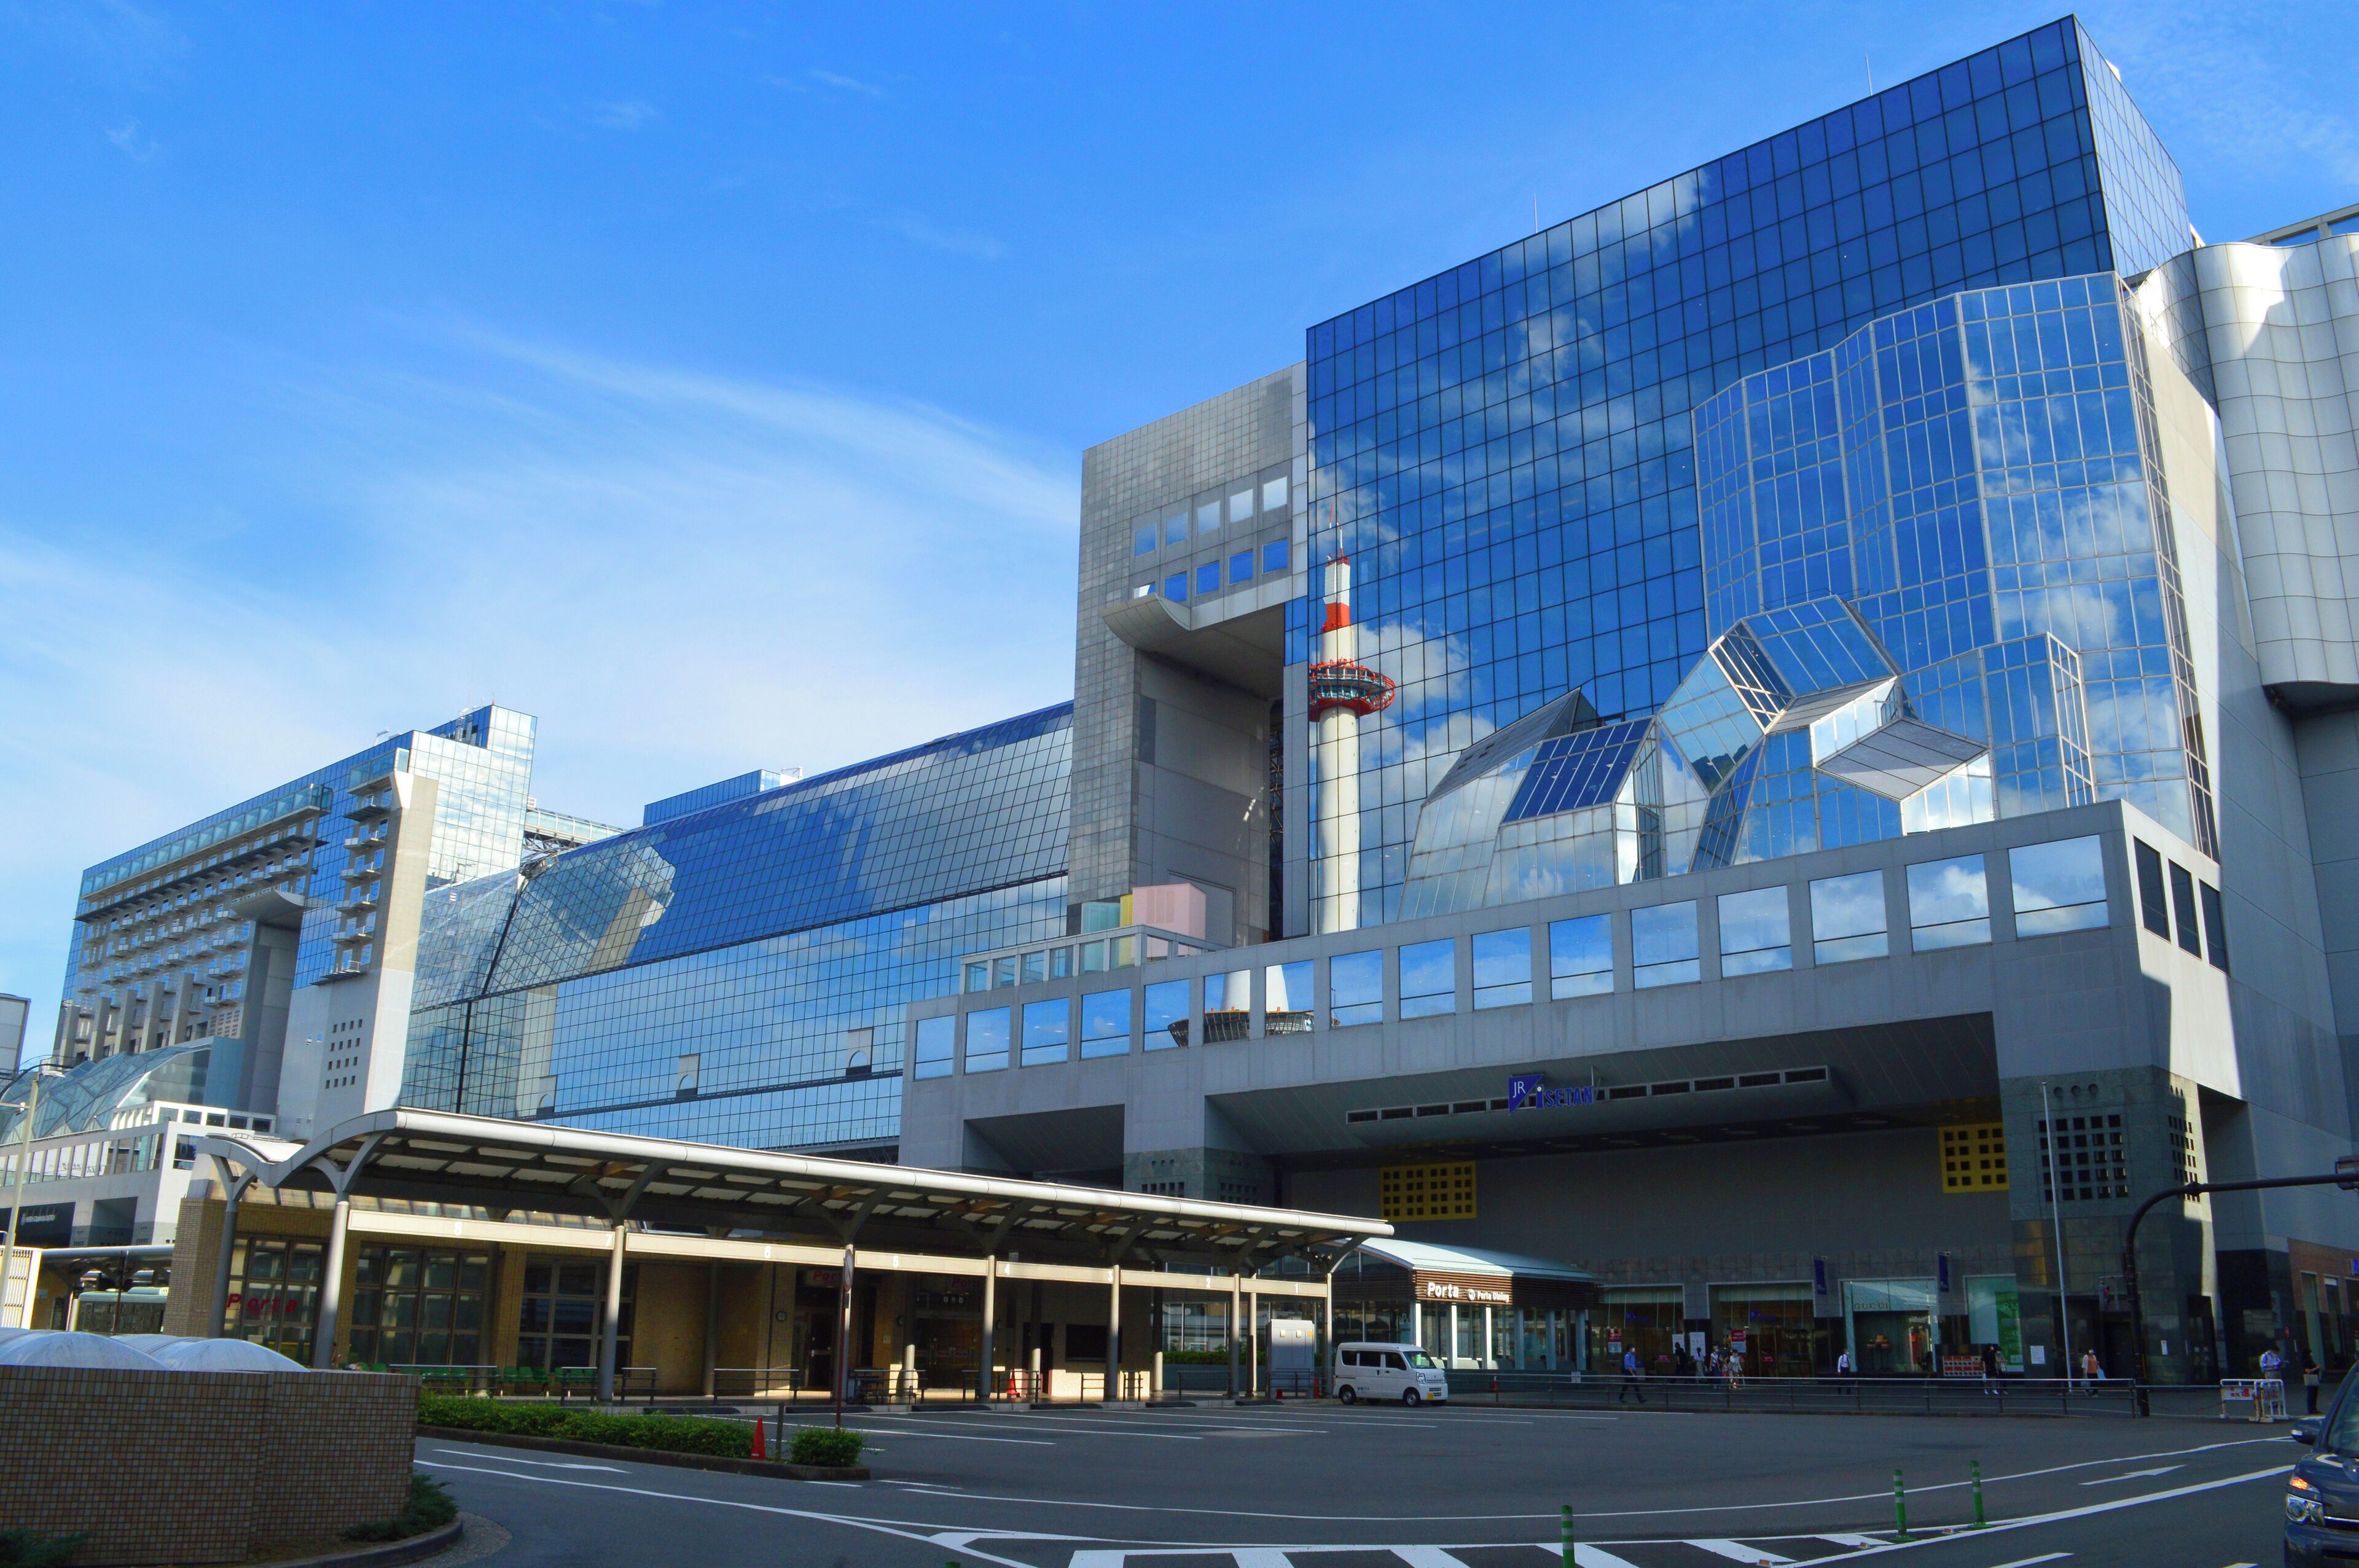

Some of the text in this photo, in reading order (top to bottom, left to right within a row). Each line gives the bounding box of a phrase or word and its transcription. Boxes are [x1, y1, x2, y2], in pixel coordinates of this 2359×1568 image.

[1512, 1081, 1526, 1098] JR
[453, 1222, 462, 1236] 8
[604, 1234, 614, 1246] 7
[764, 1246, 772, 1258] 6
[892, 1255, 899, 1268] 5
[1004, 1263, 1011, 1276] 4
[1107, 1270, 1113, 1282] 3
[1206, 1277, 1211, 1288] 2
[1294, 1283, 1299, 1293] 1
[1427, 1282, 1460, 1298] Porta
[226, 1293, 297, 1313] Porta
[1477, 1292, 1509, 1303] Porta Dining
